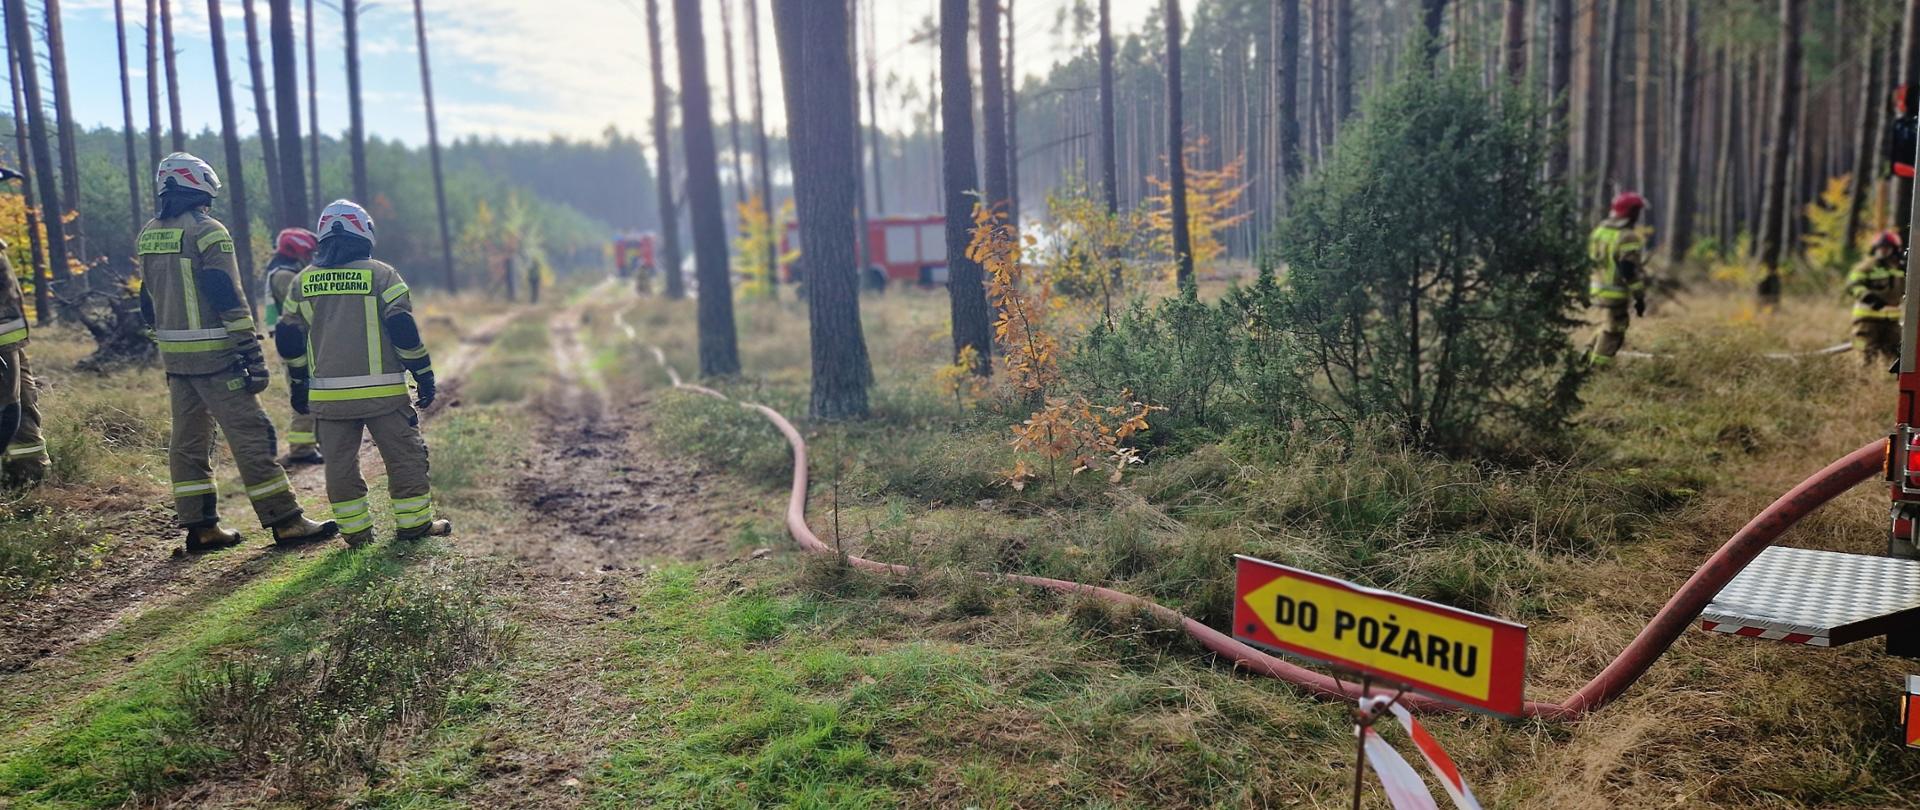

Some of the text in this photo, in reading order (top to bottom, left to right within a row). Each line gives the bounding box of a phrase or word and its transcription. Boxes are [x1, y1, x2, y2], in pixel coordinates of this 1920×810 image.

[309, 271, 362, 283] OCHOTNICZA
[1275, 594, 1478, 678] DO POŻARU
